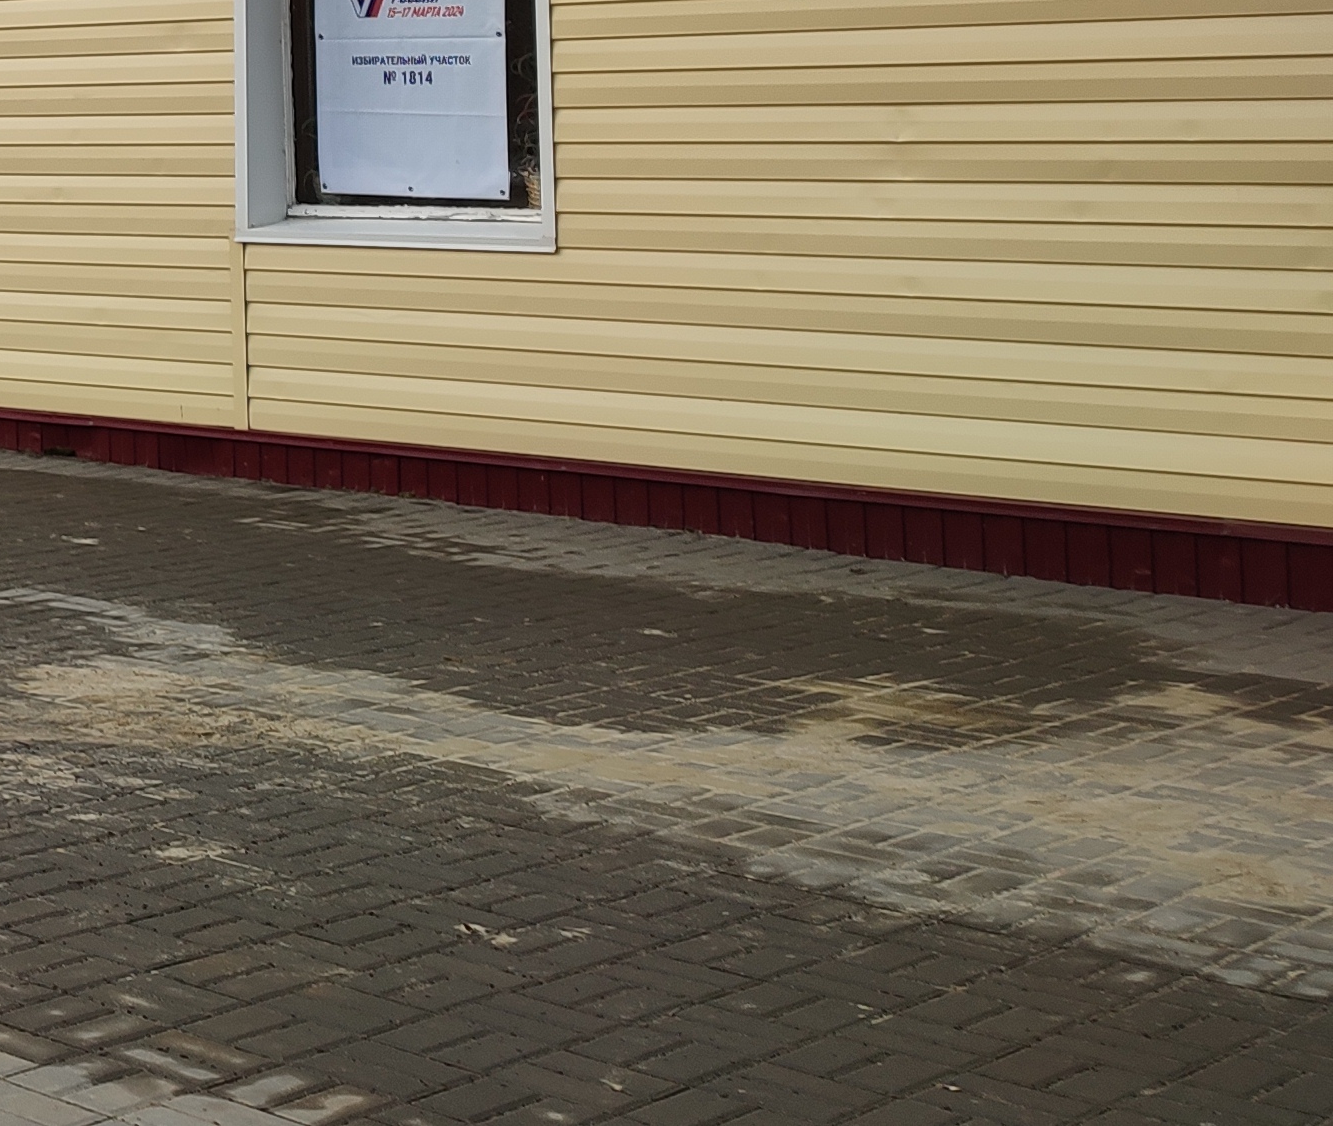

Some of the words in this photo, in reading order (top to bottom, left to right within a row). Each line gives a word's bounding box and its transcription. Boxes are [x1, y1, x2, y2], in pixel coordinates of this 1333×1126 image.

[412, 6, 442, 18] МАРТА
[442, 5, 465, 18] 2024
[351, 54, 427, 66] ИЗБИРАТЕЛЬНЫЙ
[429, 55, 471, 66] УЧАСТОК
[383, 70, 397, 85] №
[402, 70, 433, 85] 1814
